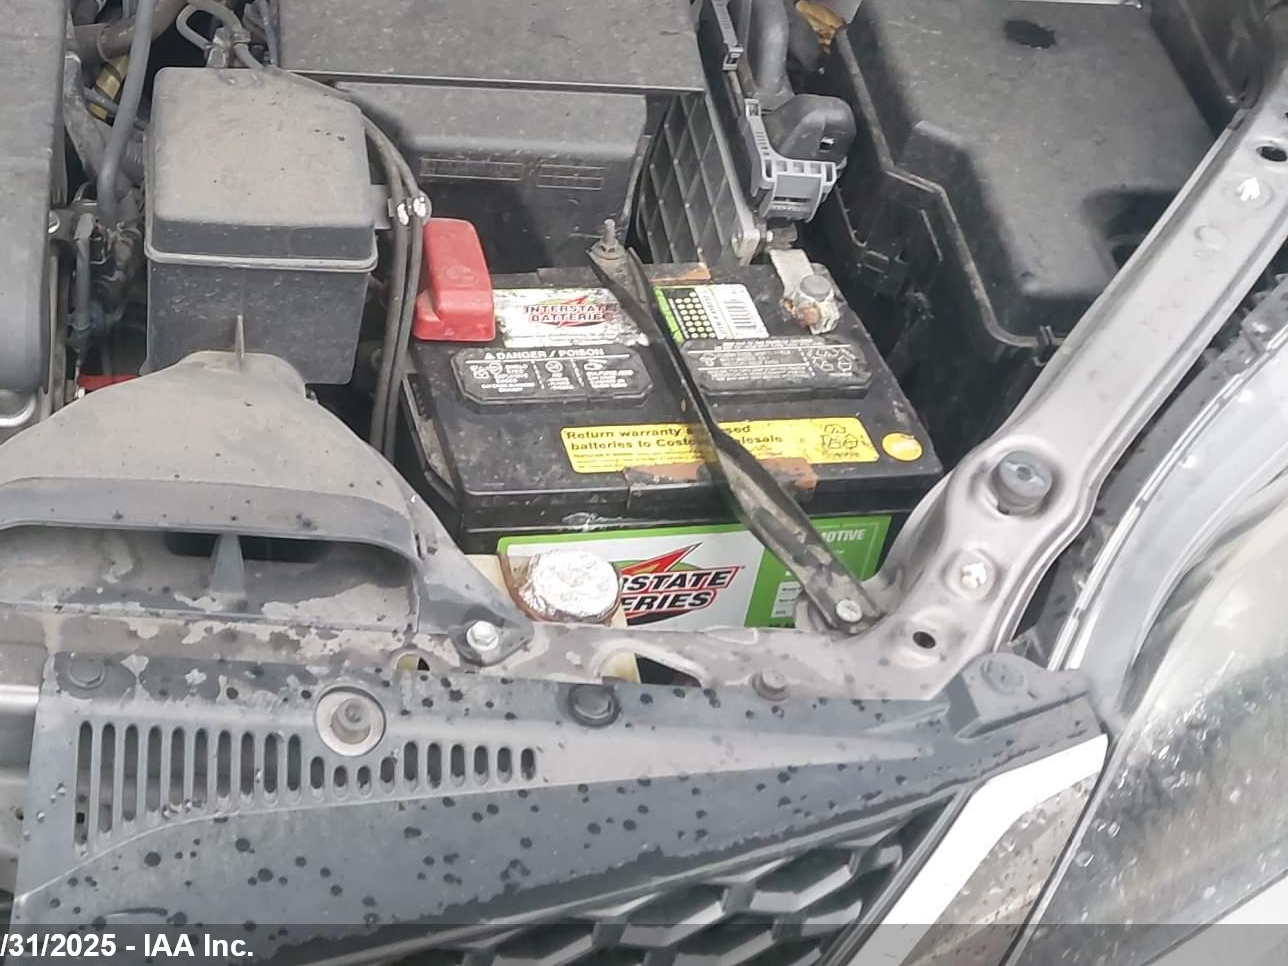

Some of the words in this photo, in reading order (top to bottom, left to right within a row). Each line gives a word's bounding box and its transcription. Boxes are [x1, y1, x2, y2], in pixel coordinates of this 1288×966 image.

[523, 303, 617, 314] INTERSTATE
[496, 350, 547, 360] DANGER
[558, 348, 605, 358] POISON
[566, 431, 614, 440] Return
[619, 428, 682, 438] warranty
[725, 425, 751, 434] sed
[571, 441, 633, 451] batteries
[638, 440, 651, 448] to
[741, 435, 783, 444] lesale
[620, 591, 713, 611] ERIES
